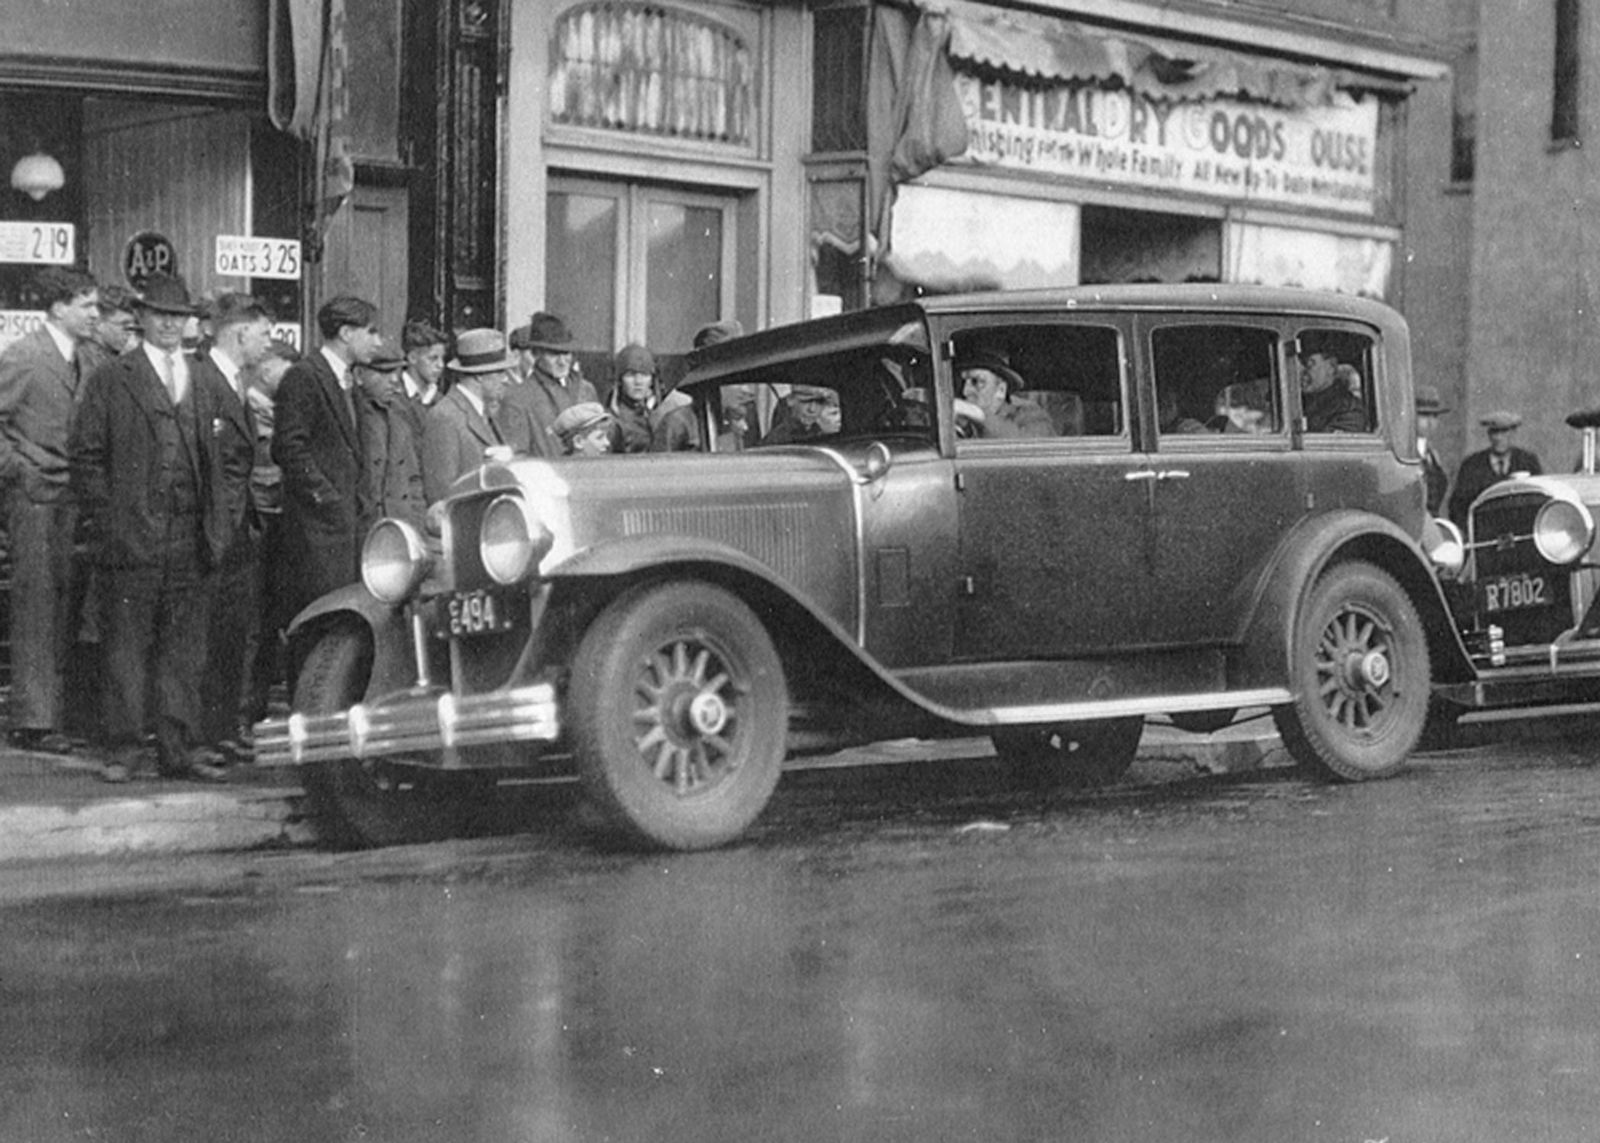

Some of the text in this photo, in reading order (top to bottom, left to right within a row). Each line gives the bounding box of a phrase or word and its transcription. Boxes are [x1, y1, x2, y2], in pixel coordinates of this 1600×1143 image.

[1078, 140, 1128, 173] Whole
[1131, 149, 1183, 181] Family
[1194, 160, 1210, 181] All
[1311, 129, 1367, 175] OUSE
[219, 253, 257, 272] OATS
[1485, 577, 1545, 611] R7802
